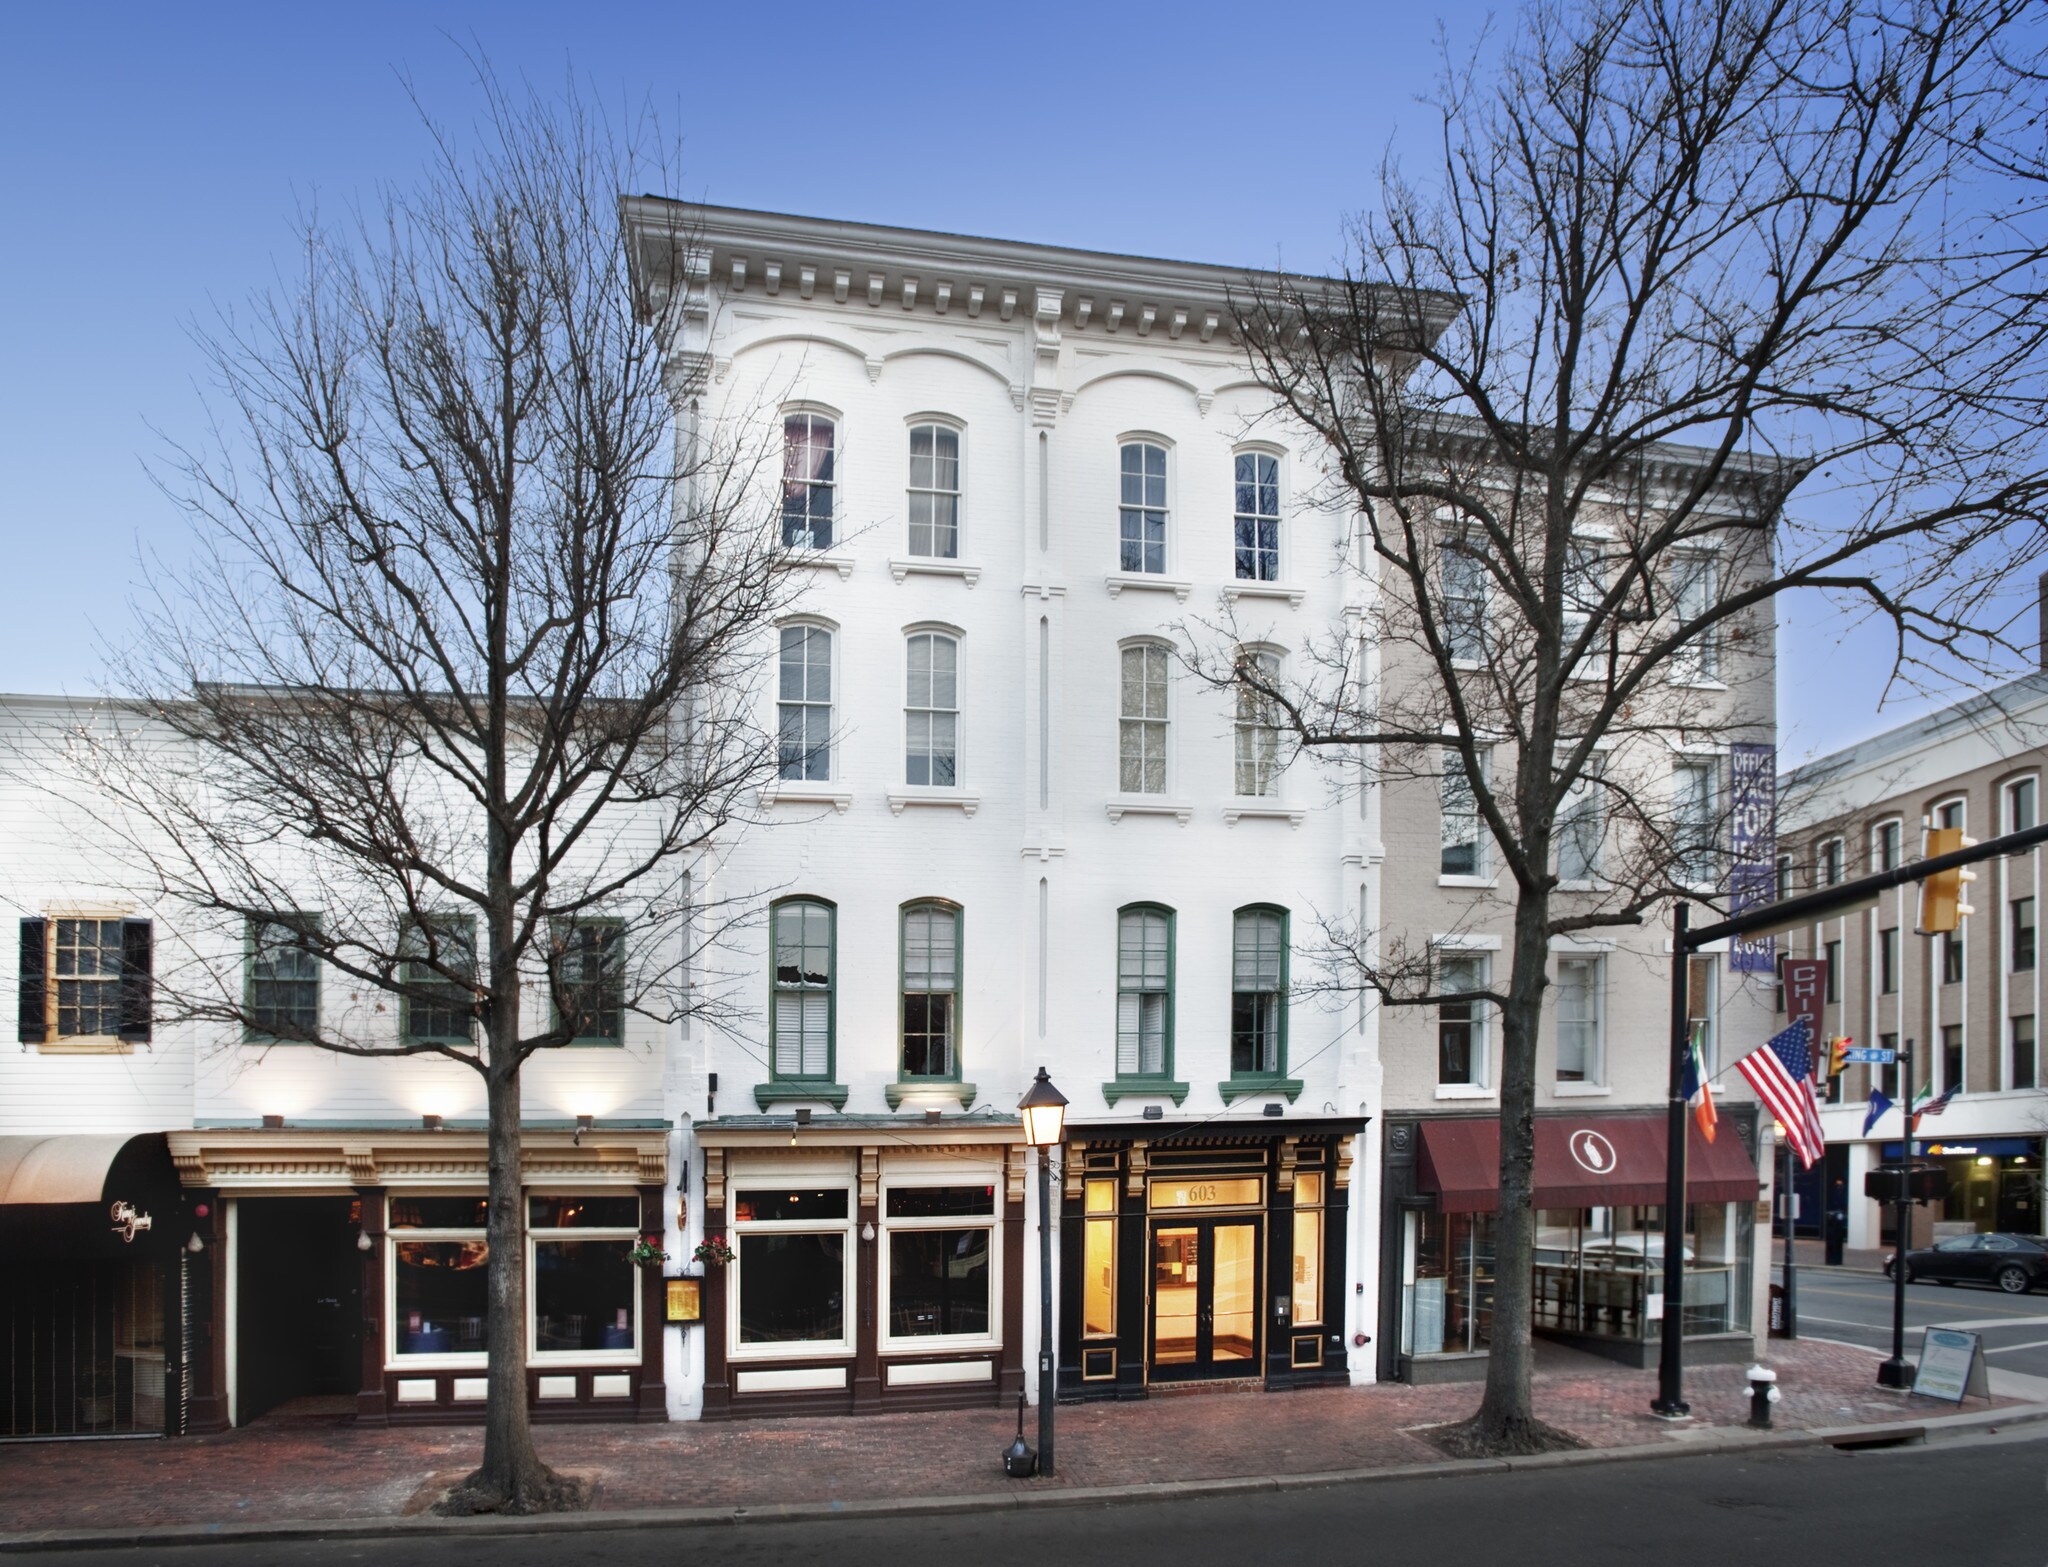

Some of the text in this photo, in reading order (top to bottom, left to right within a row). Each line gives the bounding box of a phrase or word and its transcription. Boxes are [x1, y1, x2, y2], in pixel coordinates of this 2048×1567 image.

[1733, 753, 1773, 774] OFFICE
[1733, 775, 1773, 799] SPACE
[1733, 802, 1773, 837] FOR
[1881, 1051, 1891, 1061] ST
[1188, 1185, 1217, 1202] 603
